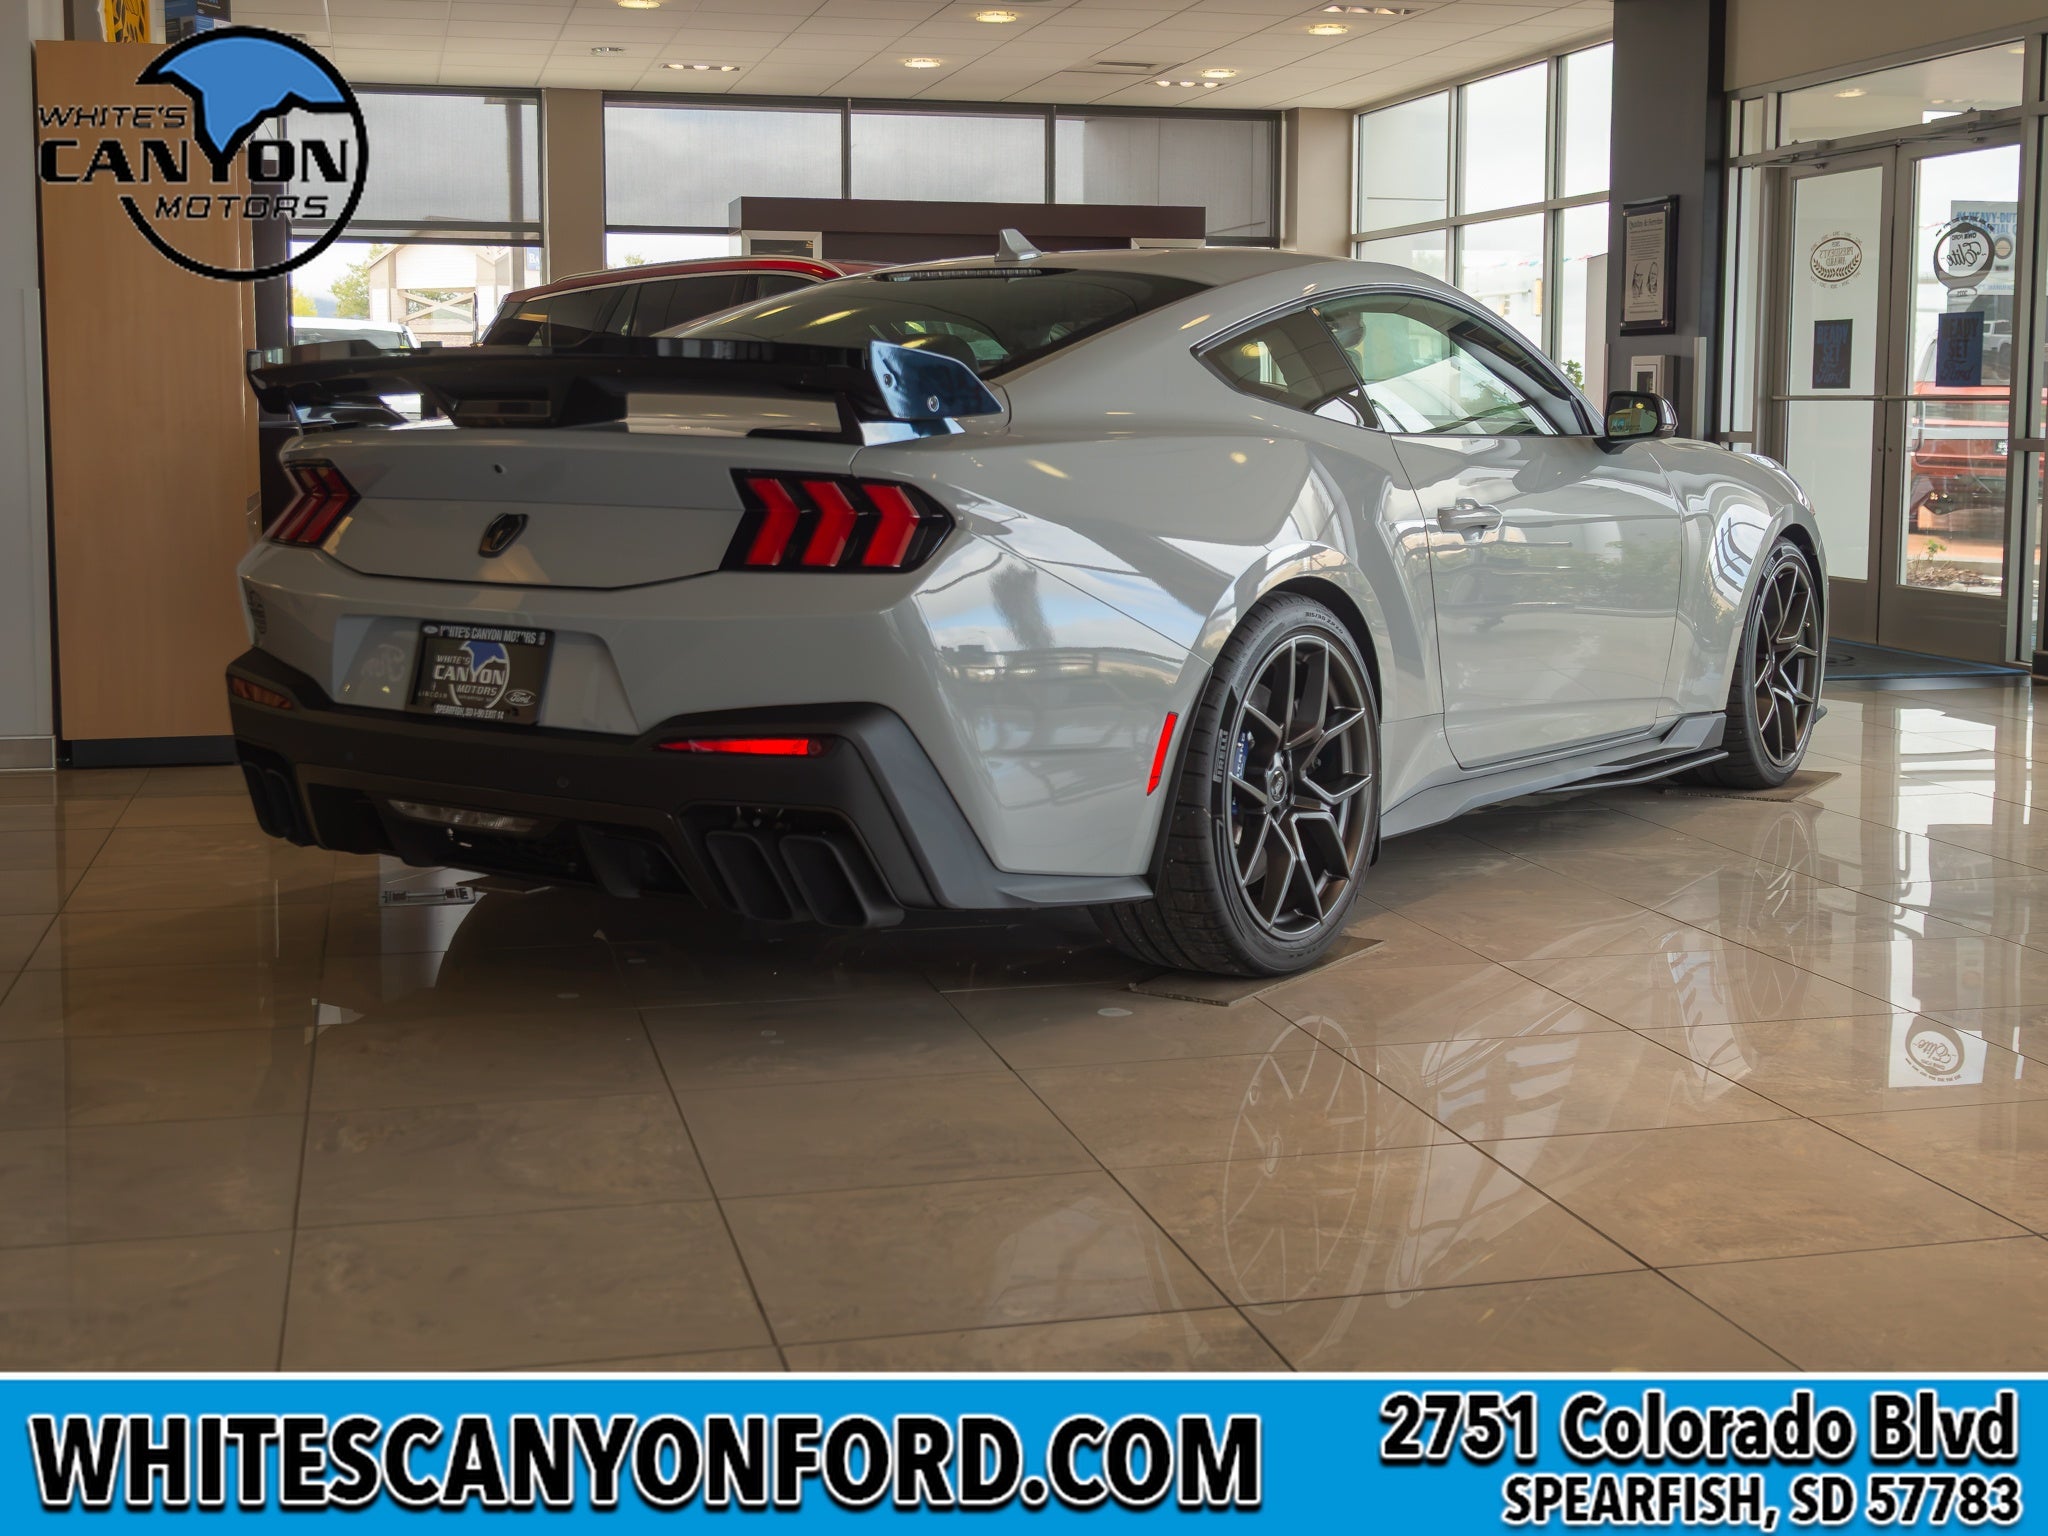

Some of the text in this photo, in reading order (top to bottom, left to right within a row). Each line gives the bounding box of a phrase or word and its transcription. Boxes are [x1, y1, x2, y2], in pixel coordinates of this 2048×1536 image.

[471, 627, 502, 641] CANYON
[434, 665, 506, 686] CANYON
[457, 684, 498, 696] MOTORS
[1212, 728, 1229, 784] PIRELLI
